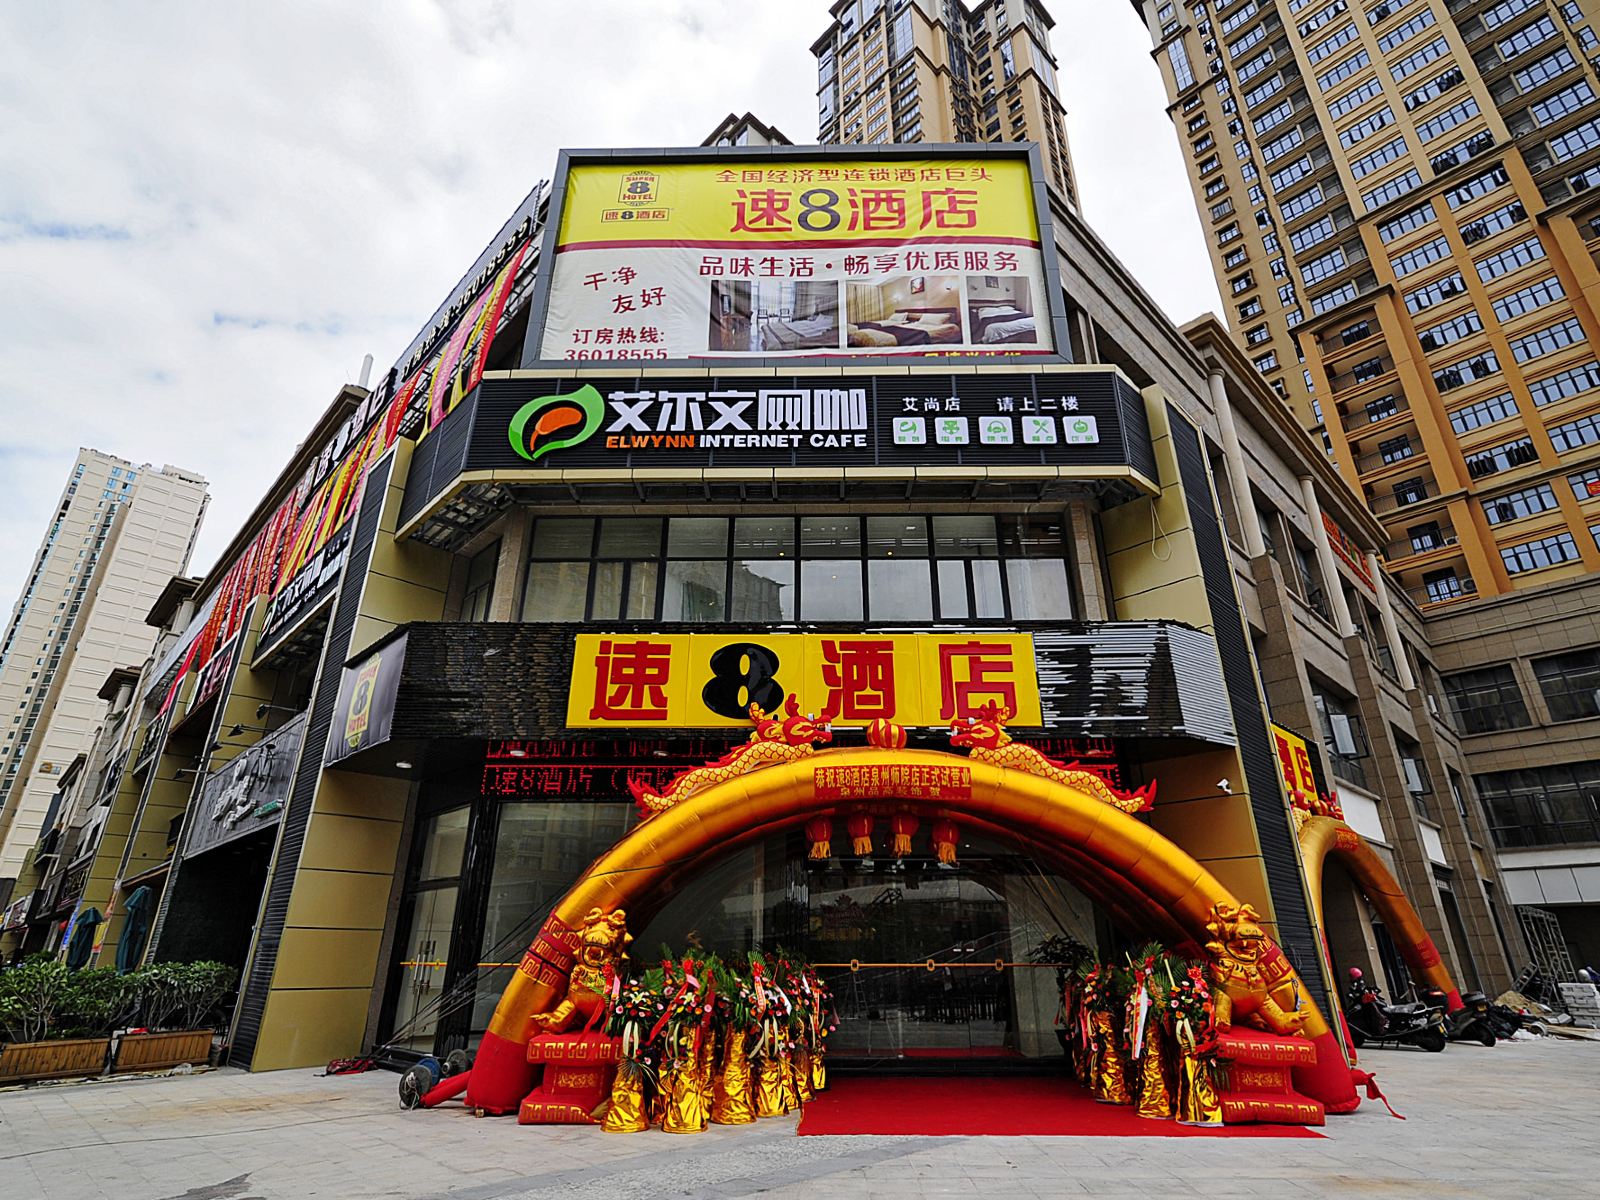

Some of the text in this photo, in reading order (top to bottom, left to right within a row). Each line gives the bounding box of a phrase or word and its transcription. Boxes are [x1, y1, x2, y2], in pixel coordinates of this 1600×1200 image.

[715, 167, 994, 183] 全国经济型连锁酒店巨头
[627, 181, 650, 195] 8
[730, 187, 979, 233] 速8酒店
[611, 287, 667, 314] 友好
[564, 348, 668, 360] 36018555
[605, 389, 868, 433] 艾尔文网咖
[902, 396, 1080, 412] 艾尚店 请上二楼
[606, 433, 868, 449] ELWYNN INTERNET CAFE
[589, 640, 1019, 720] 速8酒店
